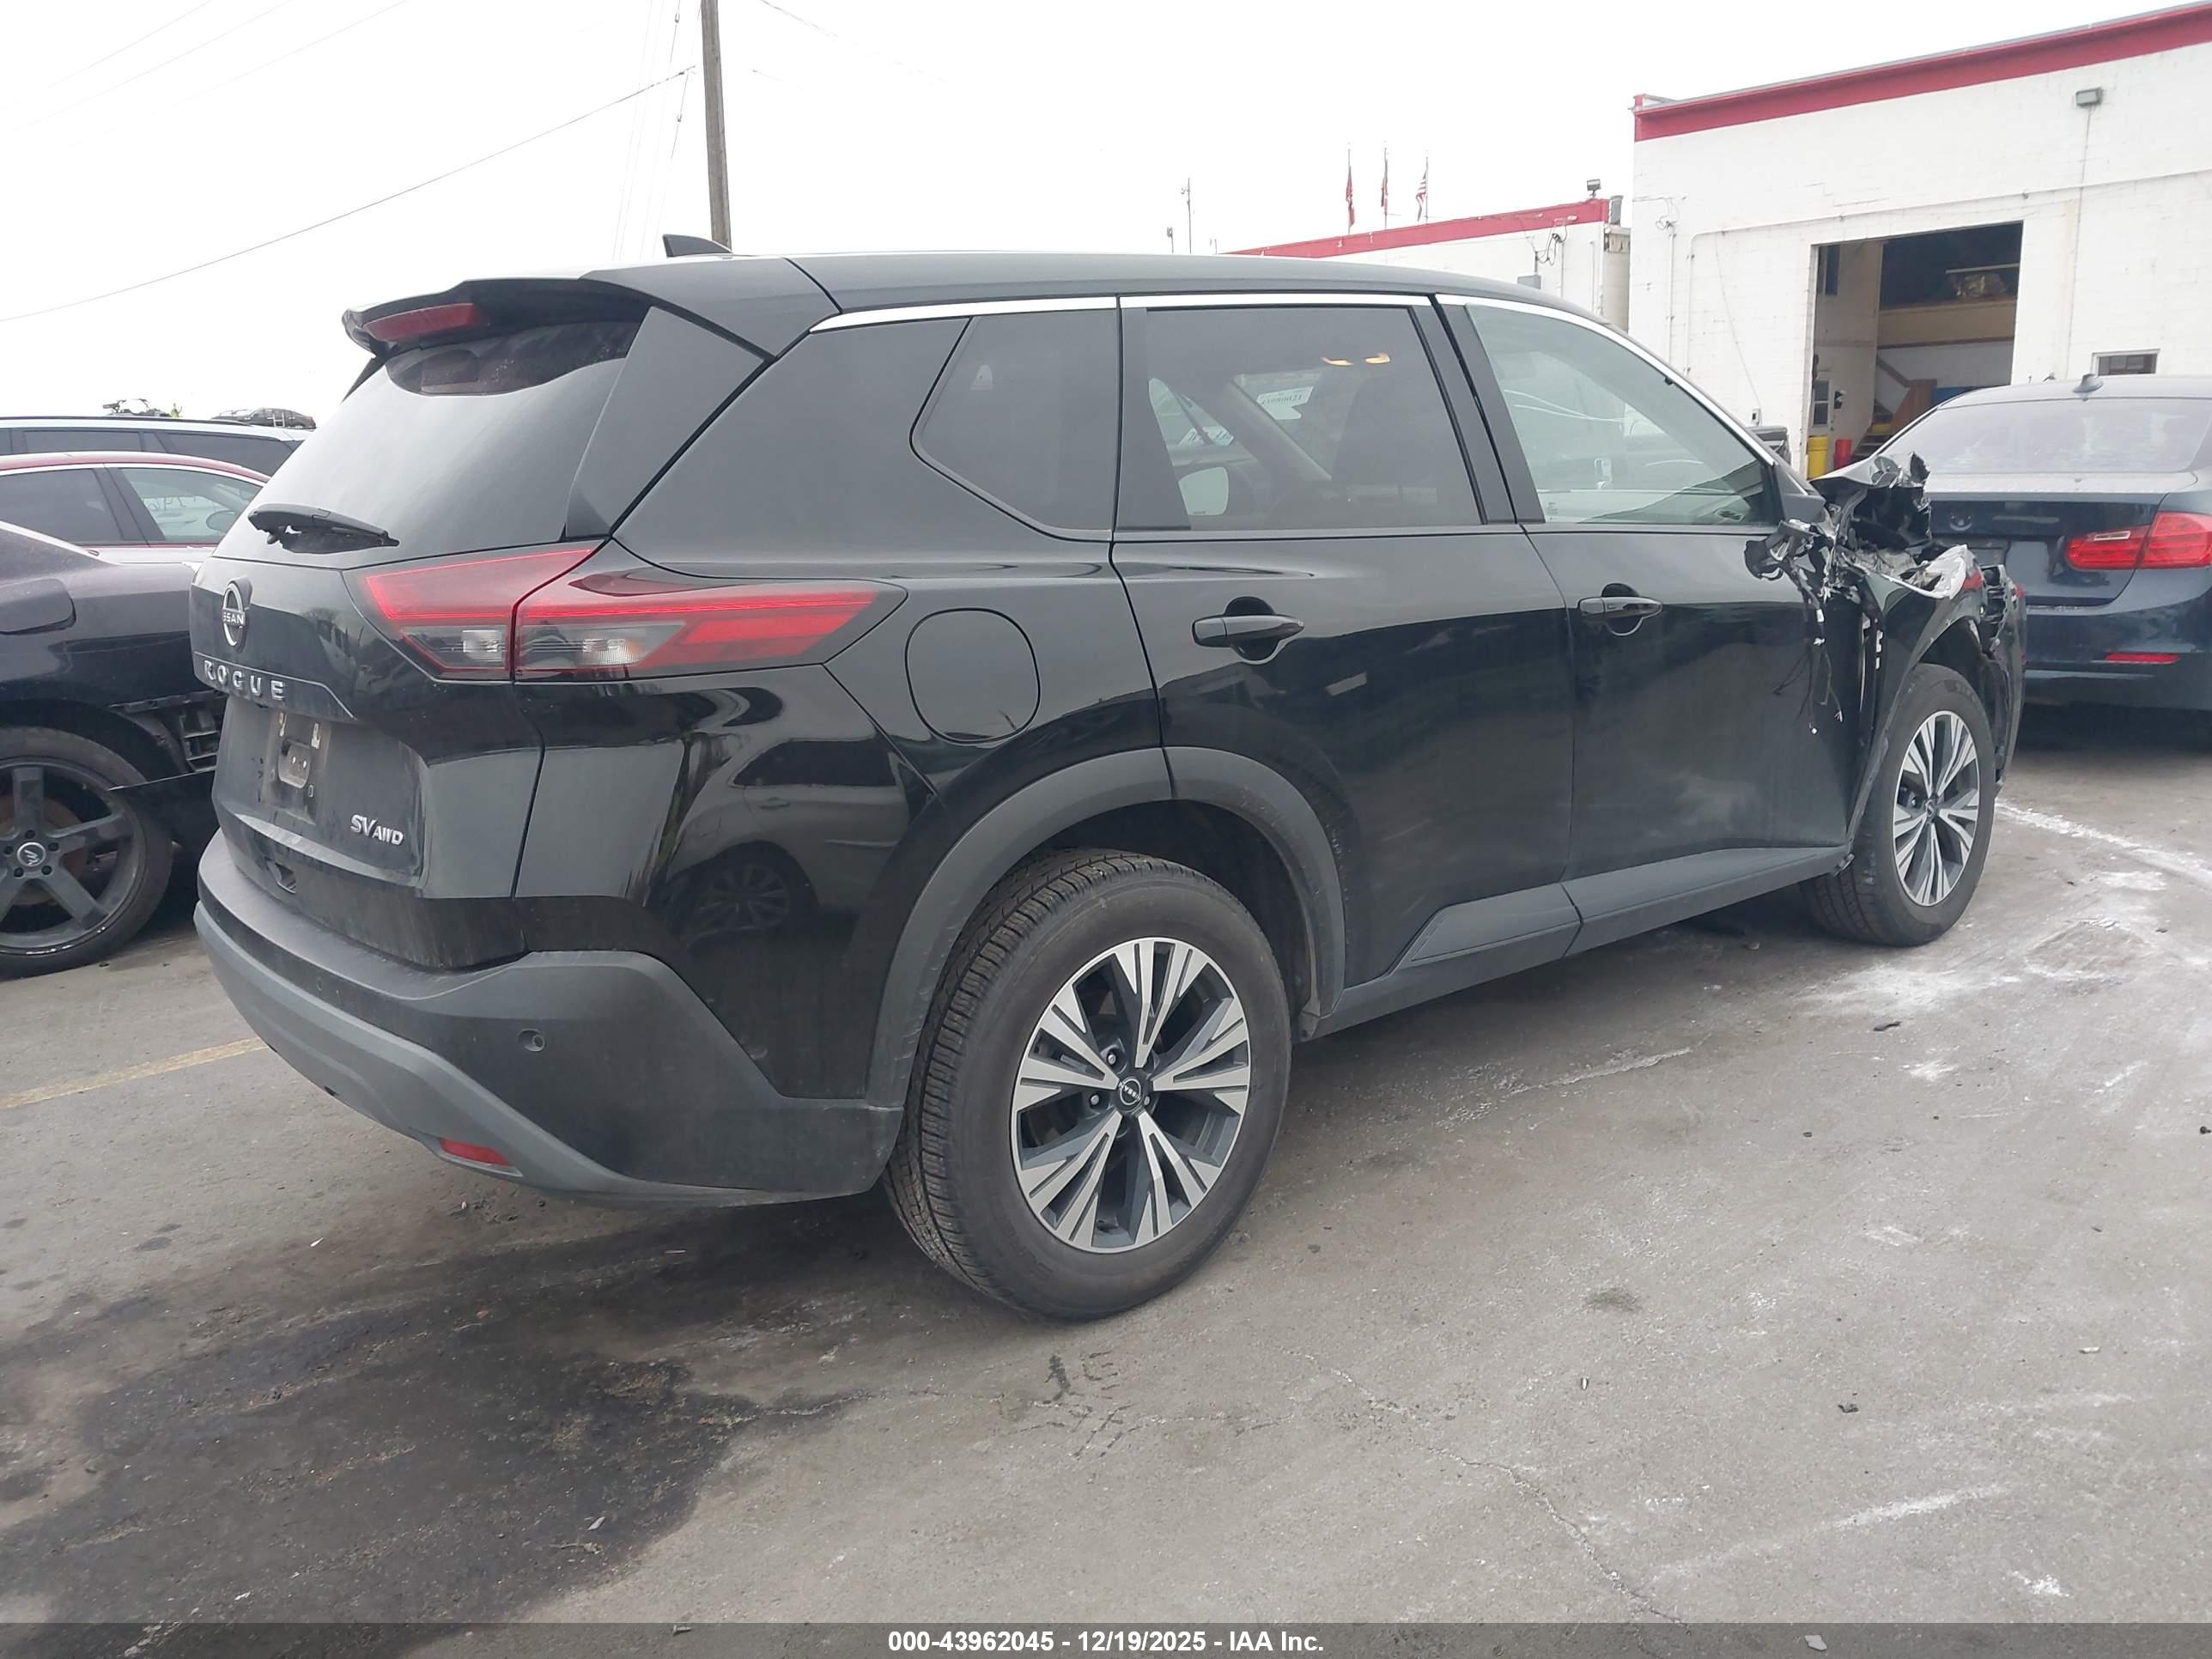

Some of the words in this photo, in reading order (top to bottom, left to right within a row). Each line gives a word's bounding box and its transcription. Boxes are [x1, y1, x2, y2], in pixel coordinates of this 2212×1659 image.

[222, 611, 245, 625] SSAN
[204, 659, 285, 701] ROGUE
[349, 814, 378, 836] SV
[372, 825, 404, 845] AWD
